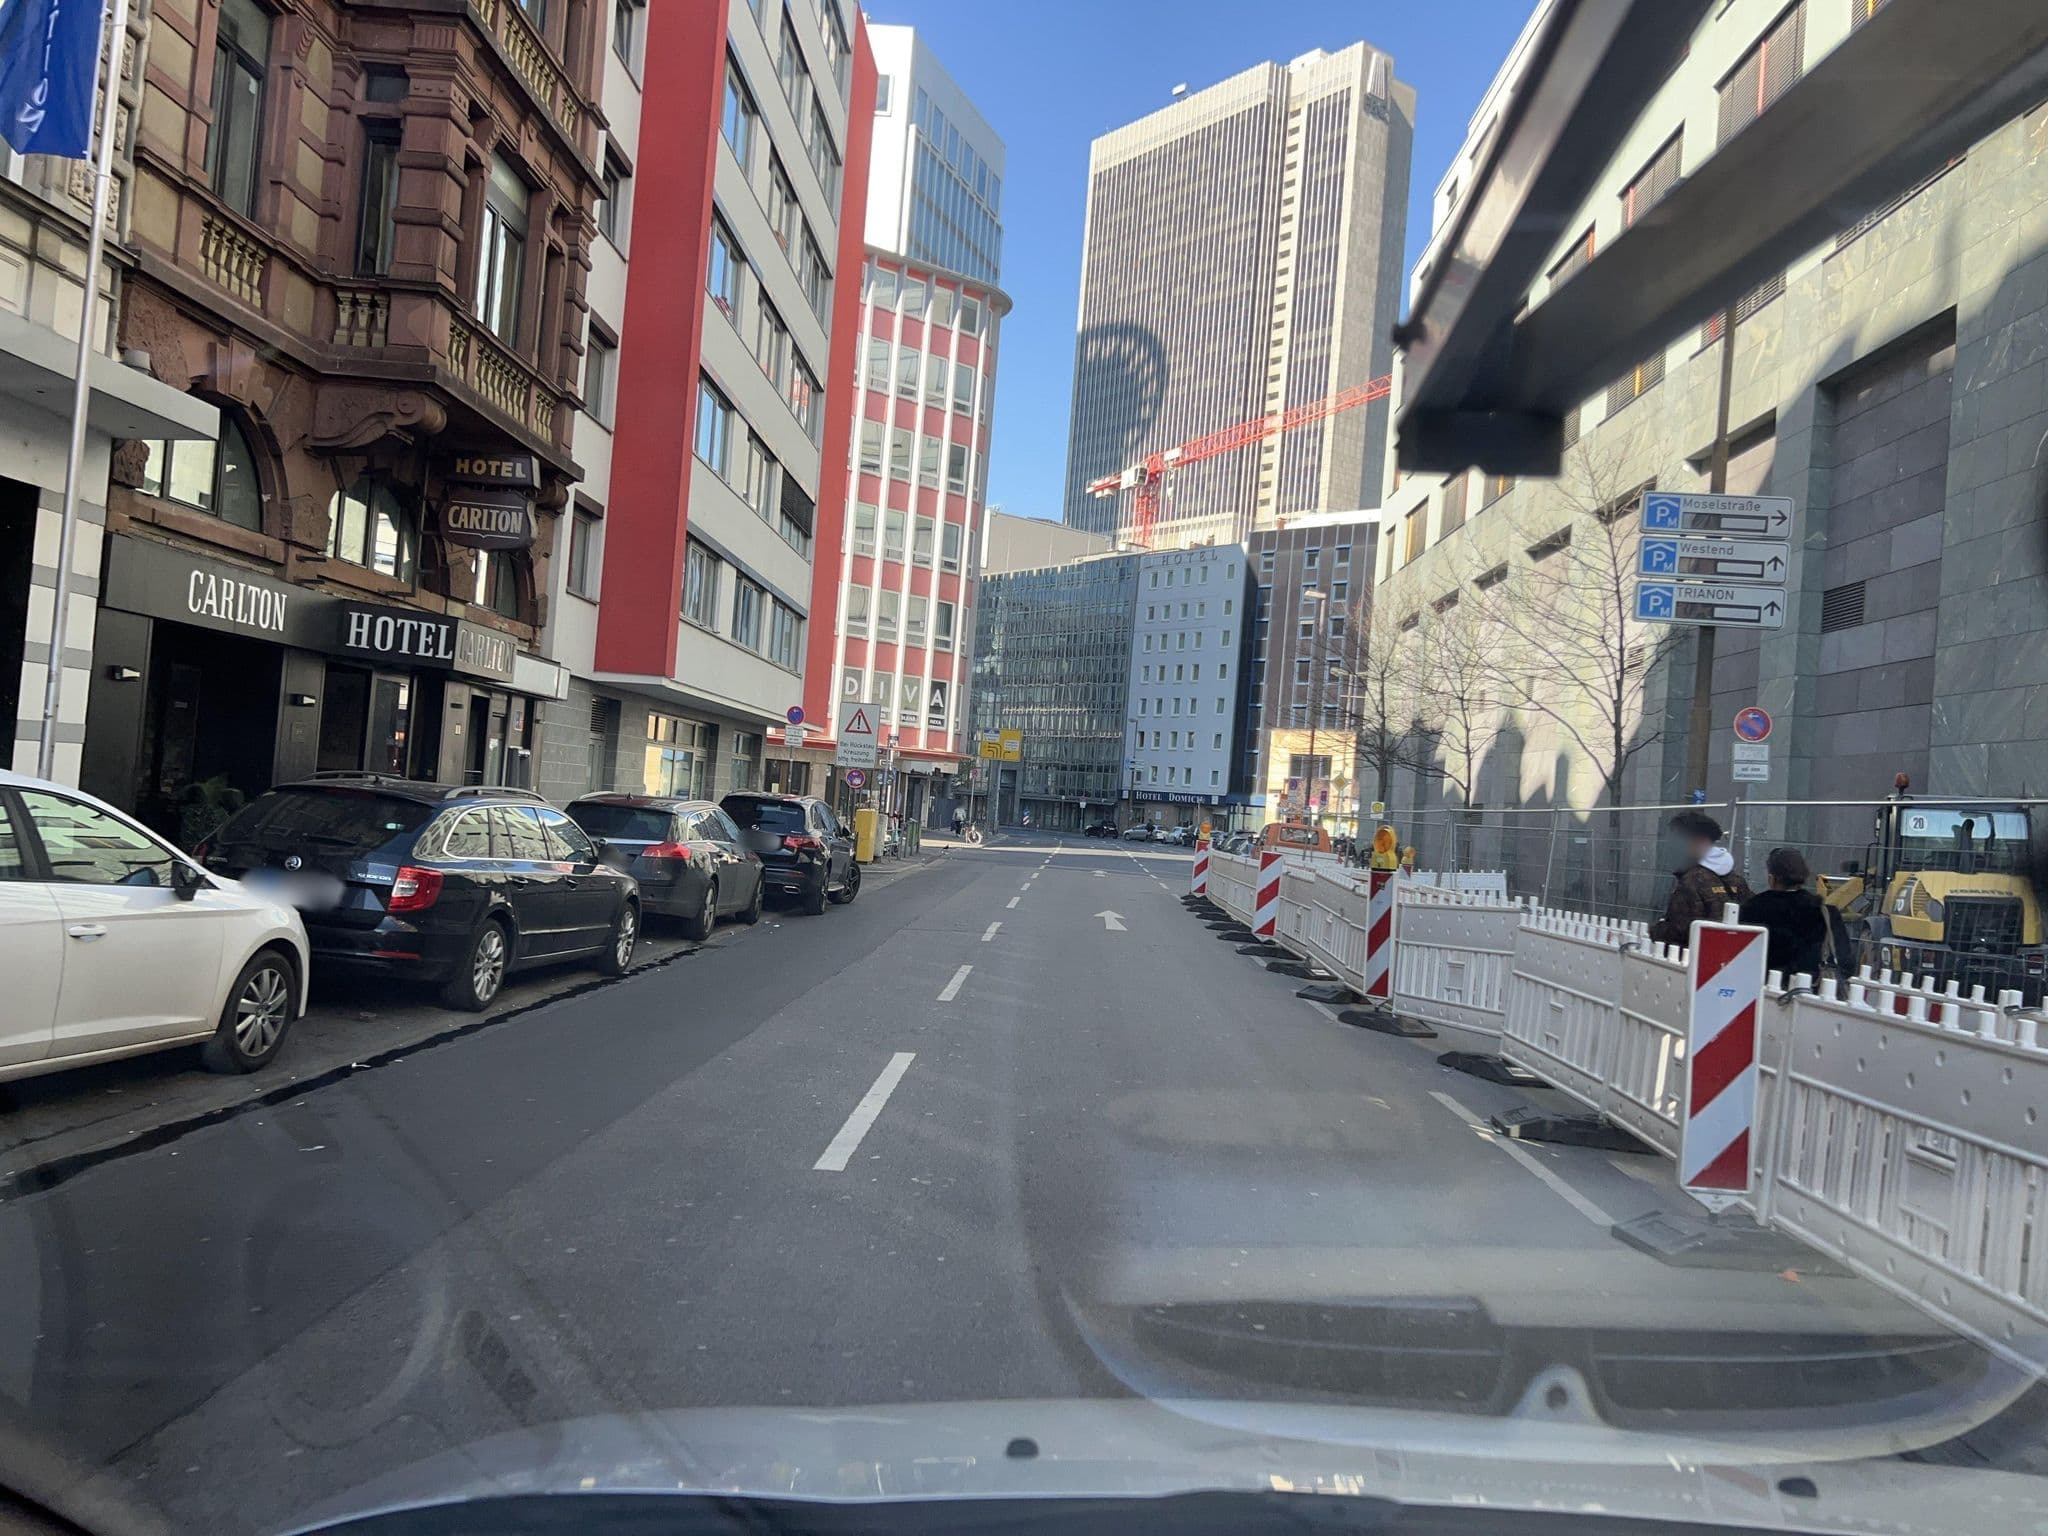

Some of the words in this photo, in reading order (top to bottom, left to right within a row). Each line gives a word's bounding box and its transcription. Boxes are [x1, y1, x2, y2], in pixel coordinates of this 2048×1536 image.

[456, 458, 526, 478] HOTEL
[1682, 498, 1761, 512] Moselstraße
[447, 505, 523, 534] CARLTON
[1656, 506, 1670, 523] P
[1667, 518, 1678, 528] M
[1161, 549, 1218, 566] HOTEL
[1680, 543, 1734, 556] Westend
[1652, 550, 1666, 567] P
[1663, 562, 1673, 572] M
[188, 570, 287, 631] CARLTON
[1677, 587, 1734, 600] TRIANON
[1649, 595, 1663, 612] P
[1660, 607, 1670, 617] M
[346, 612, 452, 660] HOTEL
[459, 629, 516, 674] CARLTON
[845, 676, 944, 708] DIVA
[843, 749, 870, 758] Kreuzung
[851, 741, 875, 750] Rückstau
[1136, 791, 1162, 801] HOTEL
[1913, 817, 1924, 829] 20
[1718, 988, 1736, 997] FST
